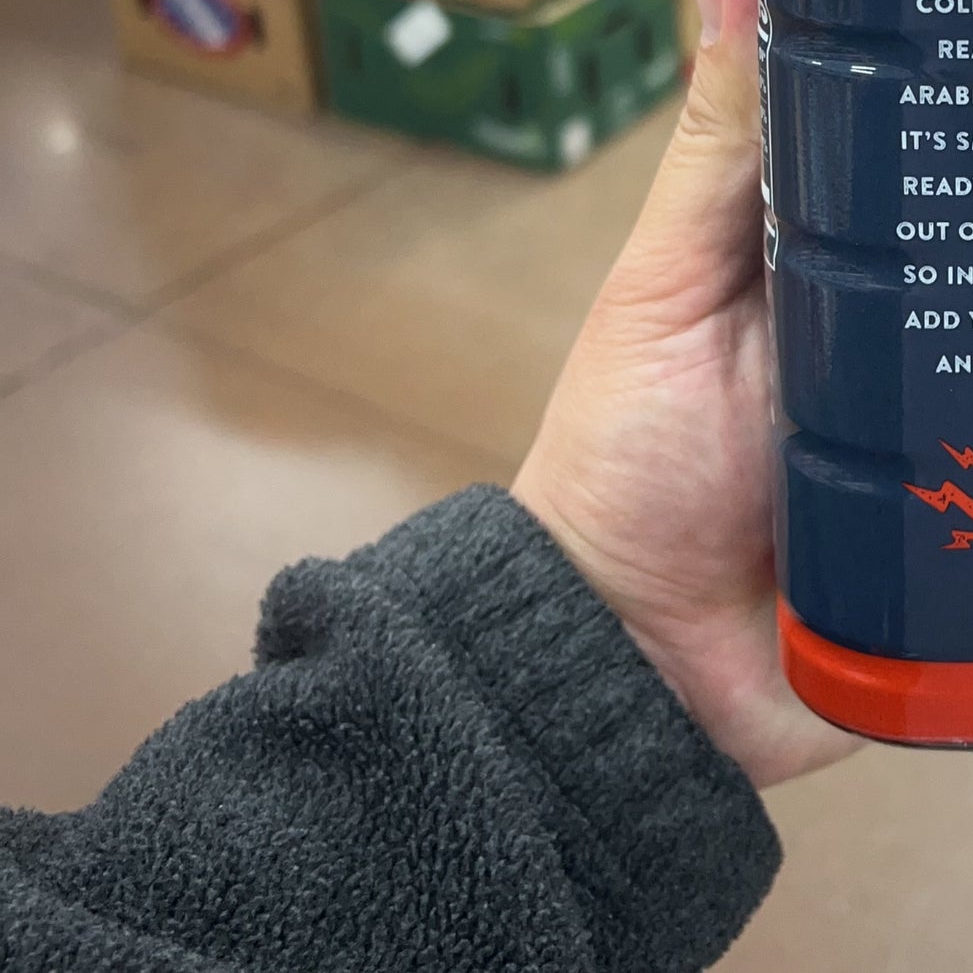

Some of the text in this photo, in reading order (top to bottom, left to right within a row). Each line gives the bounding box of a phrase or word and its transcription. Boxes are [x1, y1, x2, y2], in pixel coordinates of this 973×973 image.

[901, 130, 946, 151] IT'S
[896, 221, 949, 241] OUT
[903, 264, 937, 285] SO
[904, 310, 960, 330] ADD
